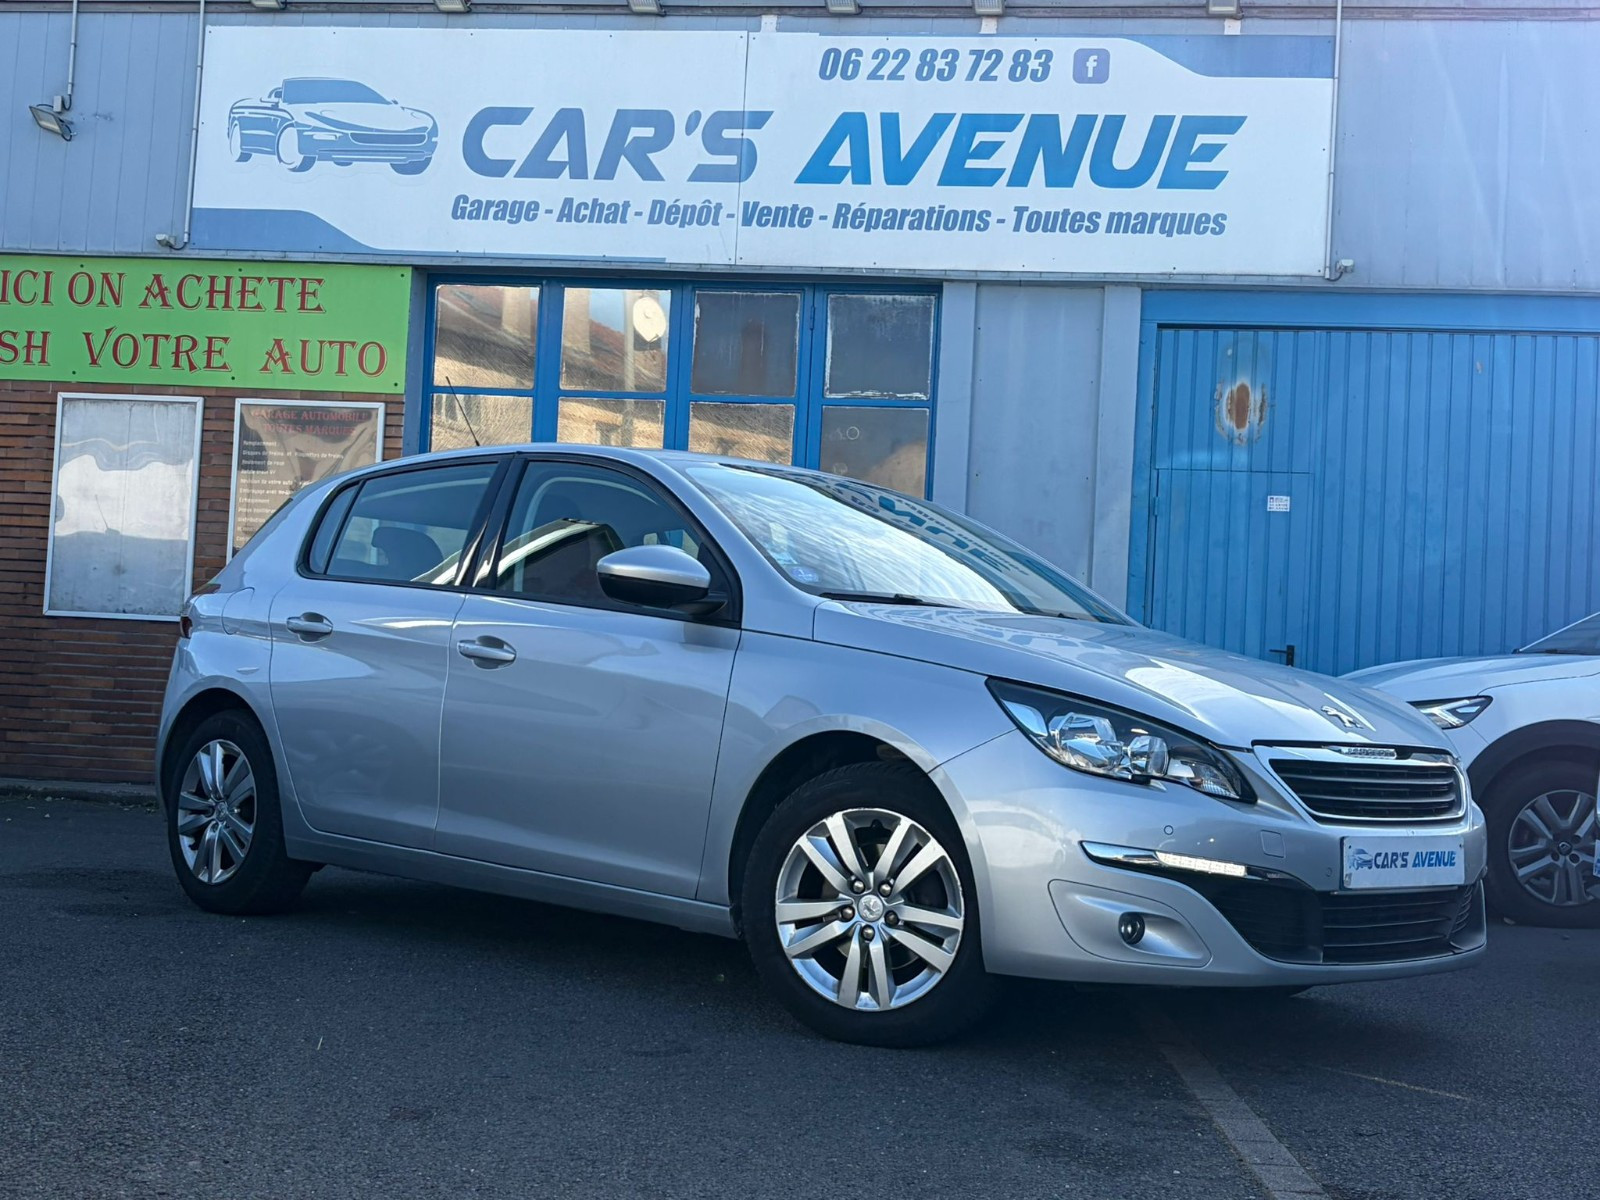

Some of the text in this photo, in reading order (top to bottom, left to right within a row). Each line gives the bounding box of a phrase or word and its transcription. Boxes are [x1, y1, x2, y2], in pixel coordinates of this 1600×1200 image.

[819, 47, 1053, 82] 06 22 83 72 83
[462, 106, 1248, 190] CAR'S AVENUE
[451, 194, 540, 225] Garage
[556, 197, 631, 225] Achat
[647, 198, 723, 228] Dépôt
[741, 200, 814, 228] Vente
[832, 202, 991, 233] Réparations
[1012, 206, 1100, 234] Toutes
[1104, 210, 1227, 238] marques
[0, 269, 327, 313] ICI ON ACHETE
[82, 326, 232, 374] VOTRE
[258, 338, 389, 377] AUTO
[1373, 850, 1458, 869] CAR'S AVENUE
